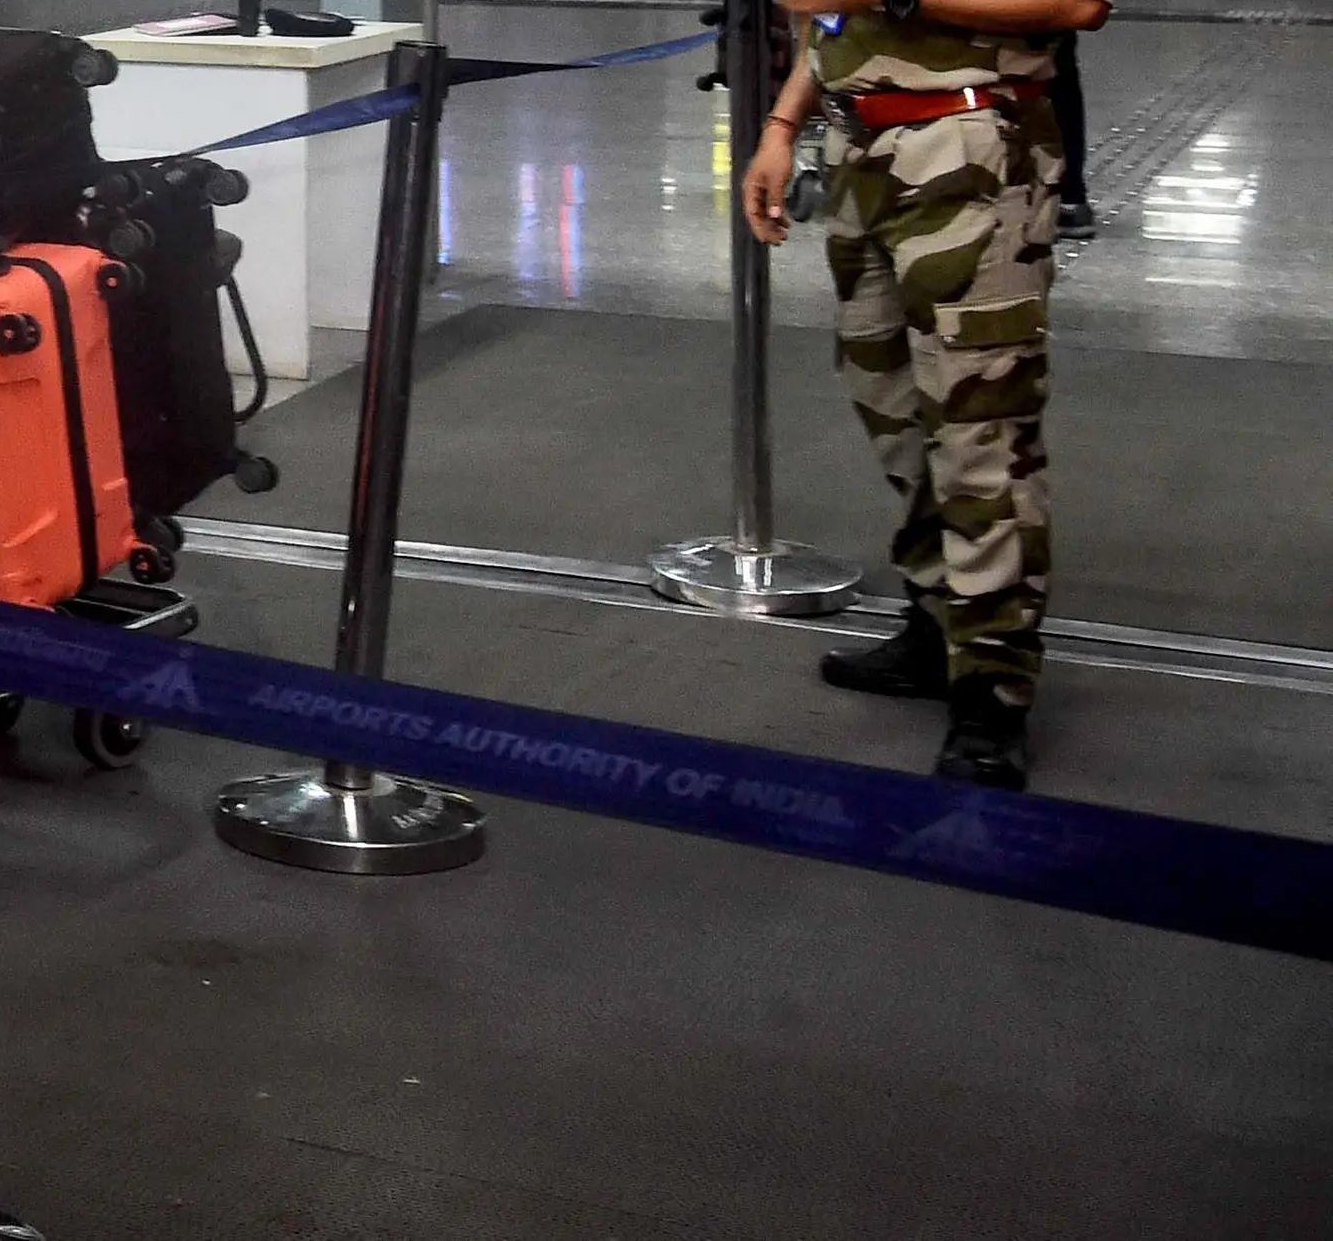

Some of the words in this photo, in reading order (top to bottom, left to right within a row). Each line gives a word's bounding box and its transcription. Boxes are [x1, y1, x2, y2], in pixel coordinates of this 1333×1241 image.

[247, 683, 433, 741] AIRPORTS
[435, 722, 663, 794] AUTHORITY
[664, 766, 726, 799] OF
[730, 777, 857, 830] INDIA
